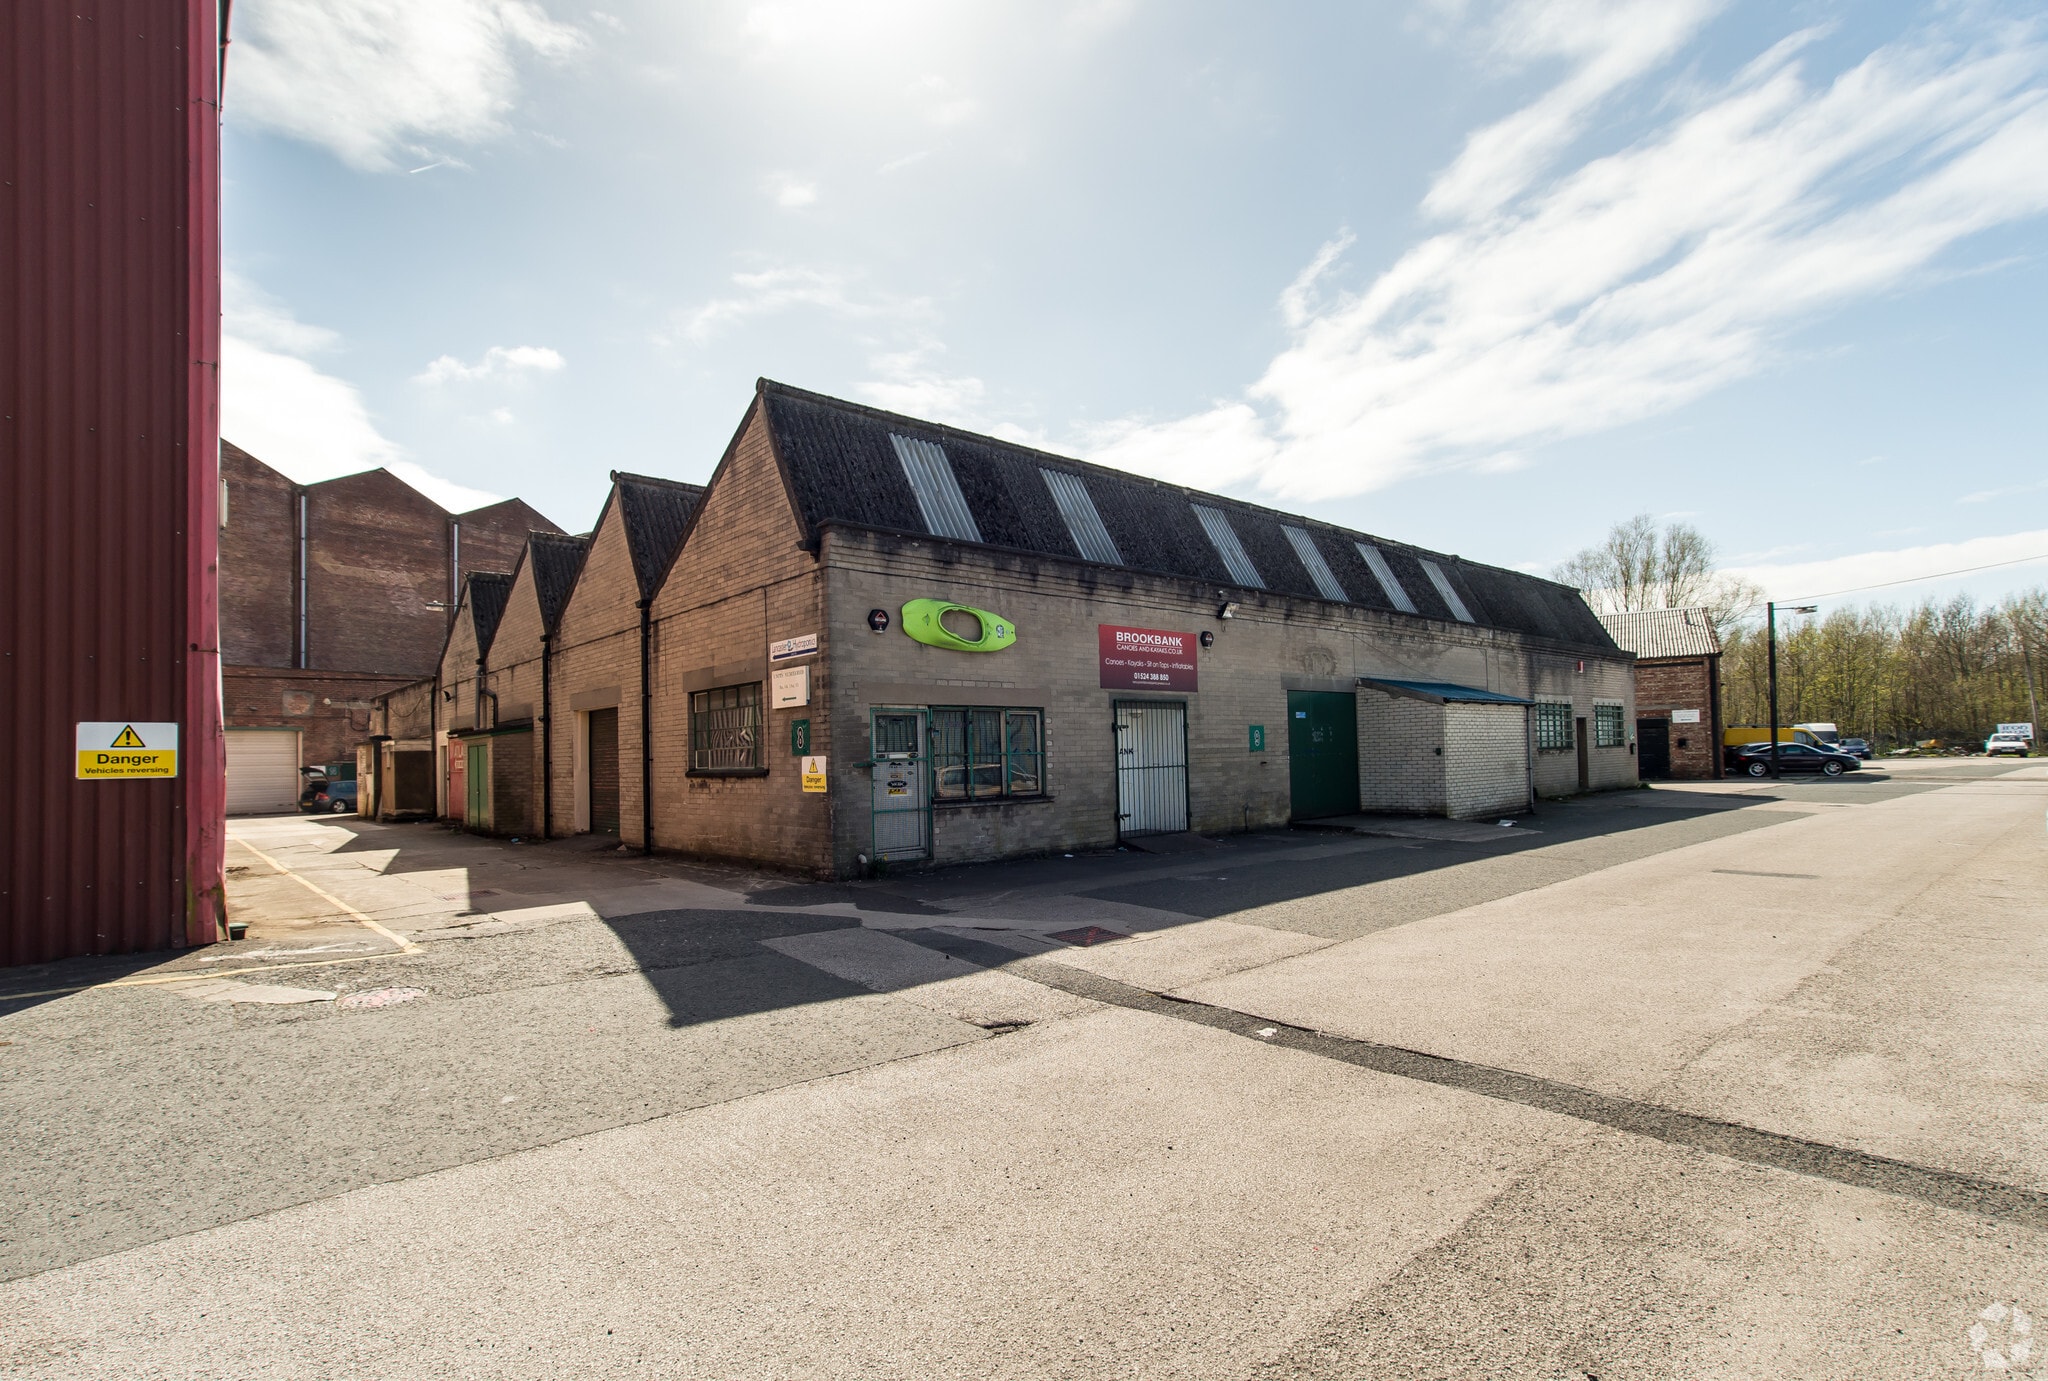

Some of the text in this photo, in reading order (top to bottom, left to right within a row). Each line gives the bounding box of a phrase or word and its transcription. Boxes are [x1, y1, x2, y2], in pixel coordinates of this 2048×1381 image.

[1116, 632, 1183, 646] BROOKBANK
[1116, 644, 1138, 652] CANOES
[1127, 660, 1144, 668] Kayaks
[1171, 662, 1194, 671] Inflatables
[1134, 672, 1149, 680] 01524
[797, 727, 804, 748] 8
[97, 754, 158, 766] Danger
[806, 776, 822, 785] Danger
